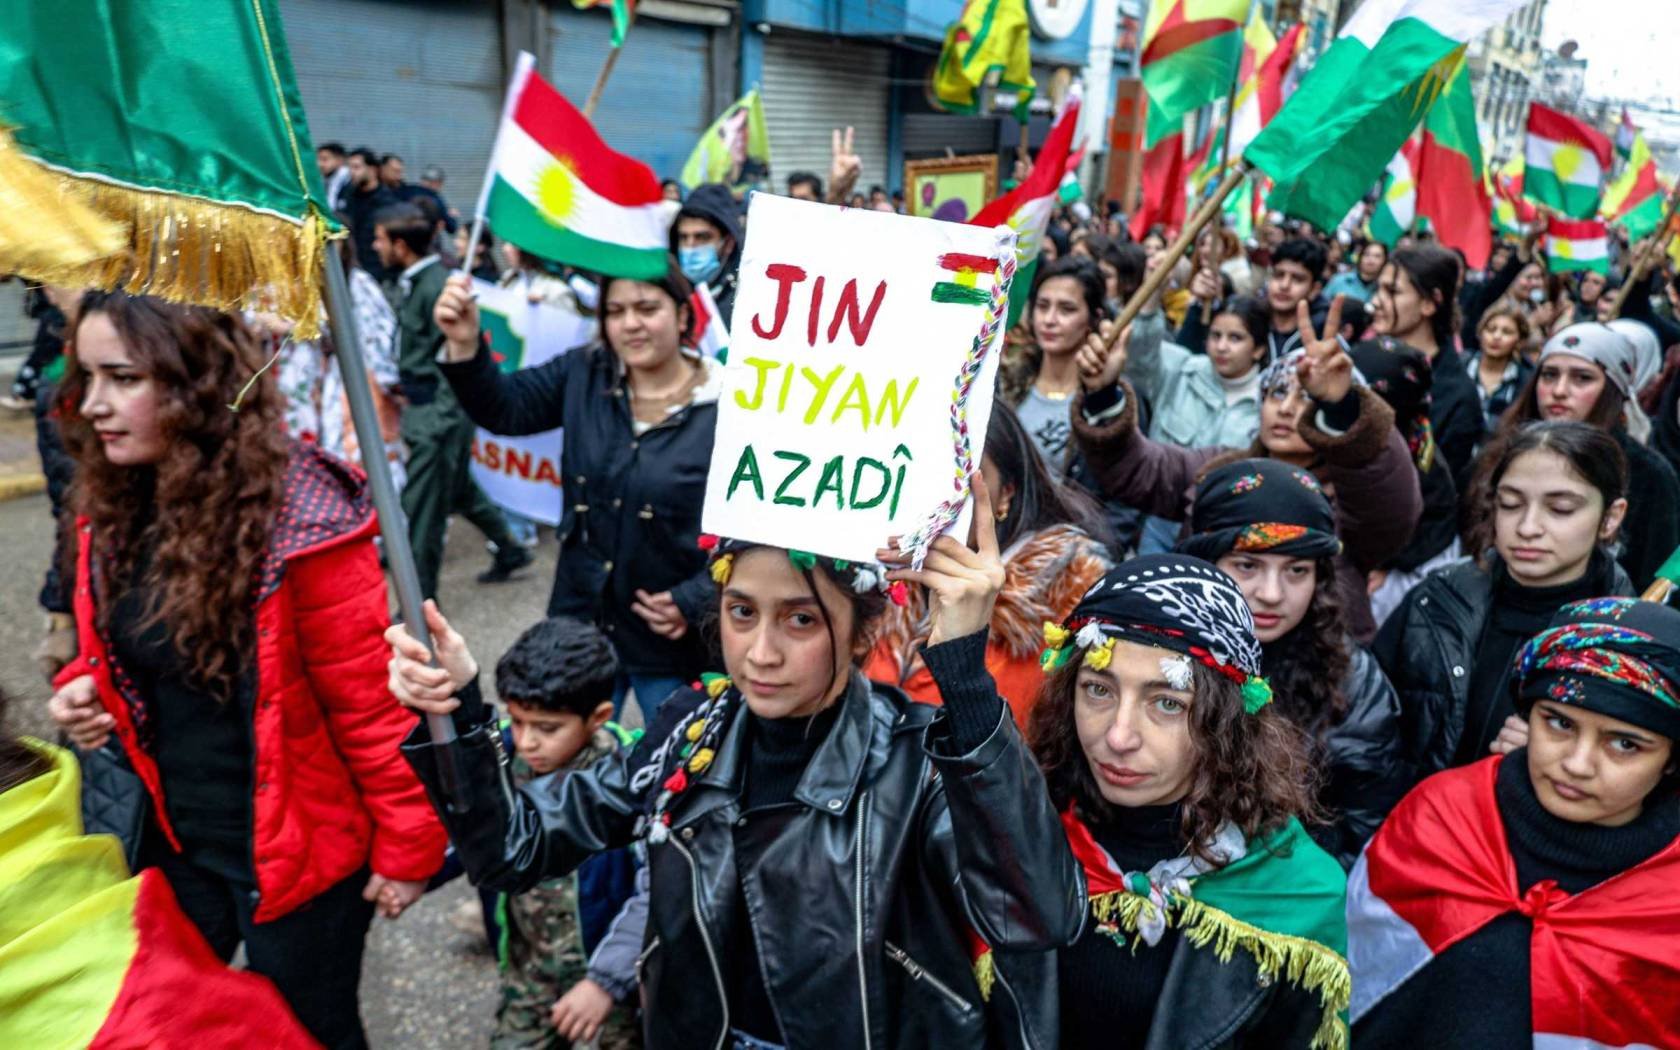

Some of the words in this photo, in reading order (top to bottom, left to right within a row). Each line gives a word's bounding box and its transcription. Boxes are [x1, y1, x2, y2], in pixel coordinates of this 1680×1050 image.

[751, 263, 888, 347] JIN
[734, 357, 920, 433] JIYAN
[726, 443, 913, 521] AZADÎ
